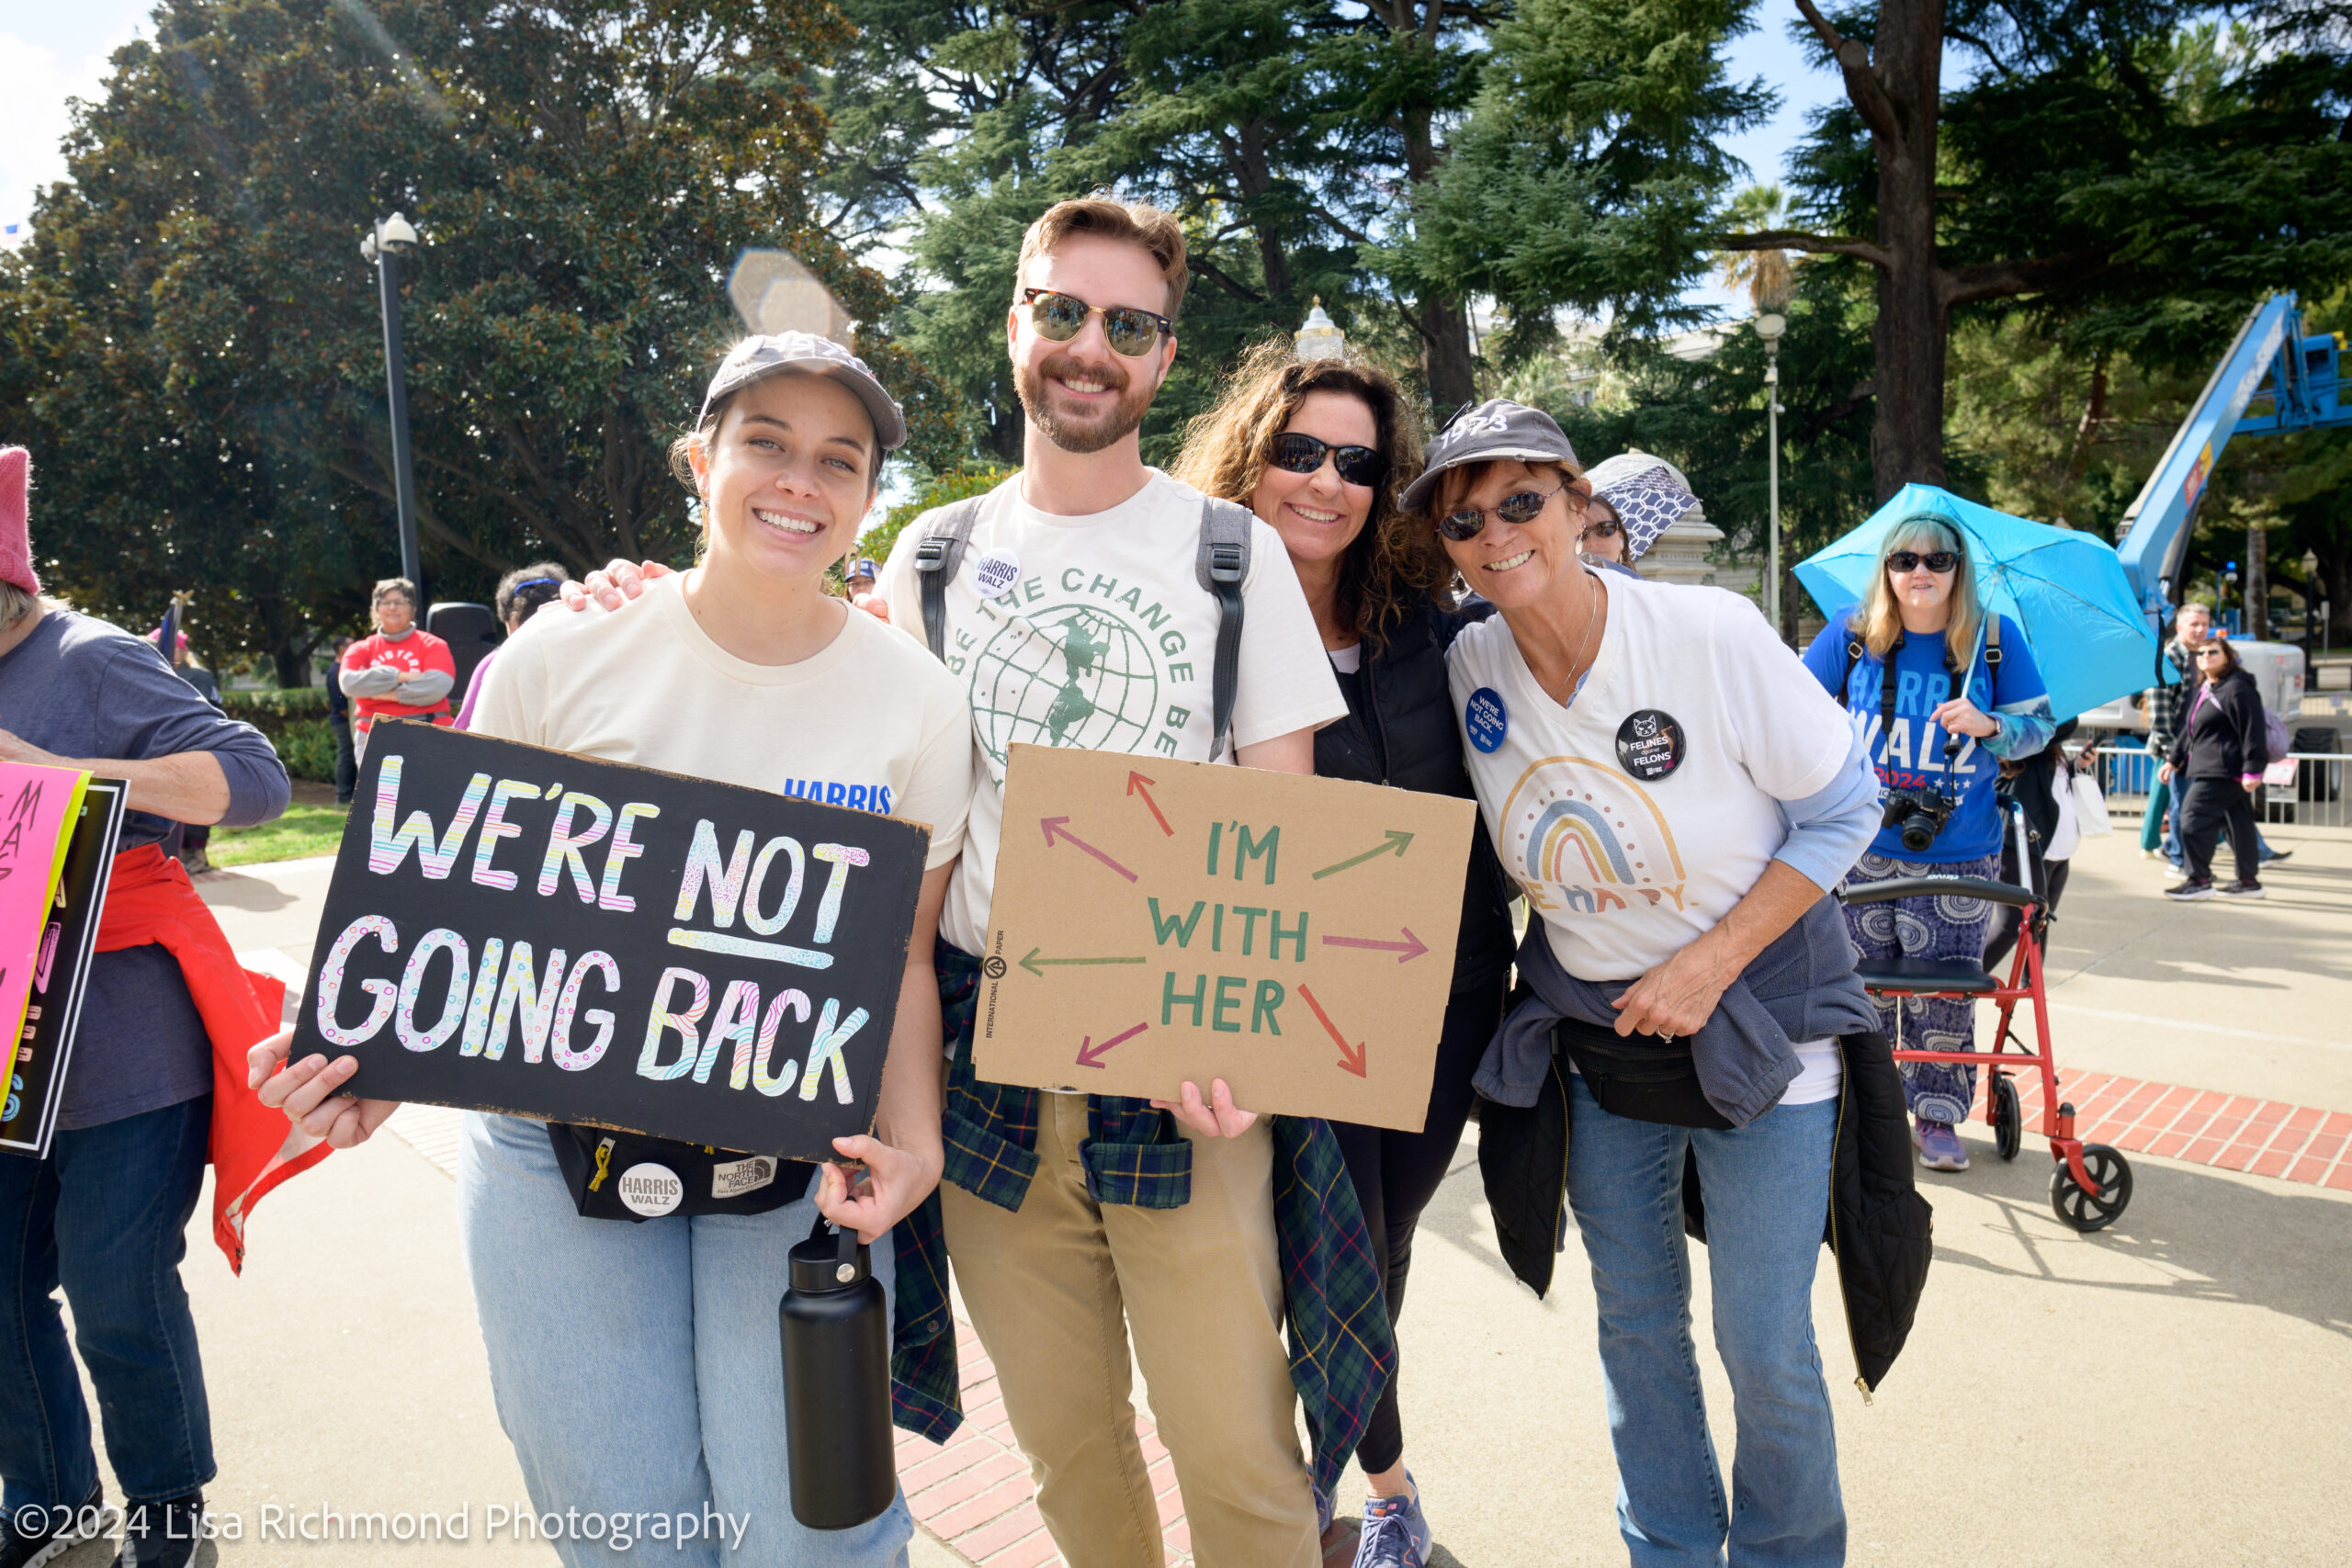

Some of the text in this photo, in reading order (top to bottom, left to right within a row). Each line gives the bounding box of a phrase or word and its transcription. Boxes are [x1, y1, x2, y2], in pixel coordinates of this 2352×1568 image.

[1441, 414, 1508, 449] 1973
[977, 557, 1017, 581] HARRIS
[978, 572, 1005, 589] WALZ
[946, 568, 1194, 758] BE THE CHANGE BE
[1849, 665, 1987, 716] HARRS
[1470, 699, 1483, 714] NOT
[1483, 711, 1504, 731] GOING
[1480, 695, 1499, 716] WE'RE
[1630, 736, 1668, 751] FELINES
[1634, 751, 1671, 767] FELONS
[1874, 767, 1928, 788] 2024
[784, 778, 891, 816] HARRIS
[368, 755, 869, 943] WE'RE NOT
[1207, 820, 1280, 885] I'M
[1147, 897, 1308, 962] WITH
[986, 931, 1004, 1038] INTERNATIONAL PAPER
[317, 915, 869, 1104] GOING BACK
[1161, 972, 1285, 1035] HER
[718, 1168, 754, 1181] NORTH
[736, 1160, 754, 1172] THE
[622, 1177, 678, 1195] HARRIS
[729, 1176, 754, 1188] FACE
[630, 1195, 670, 1205] WALZ
